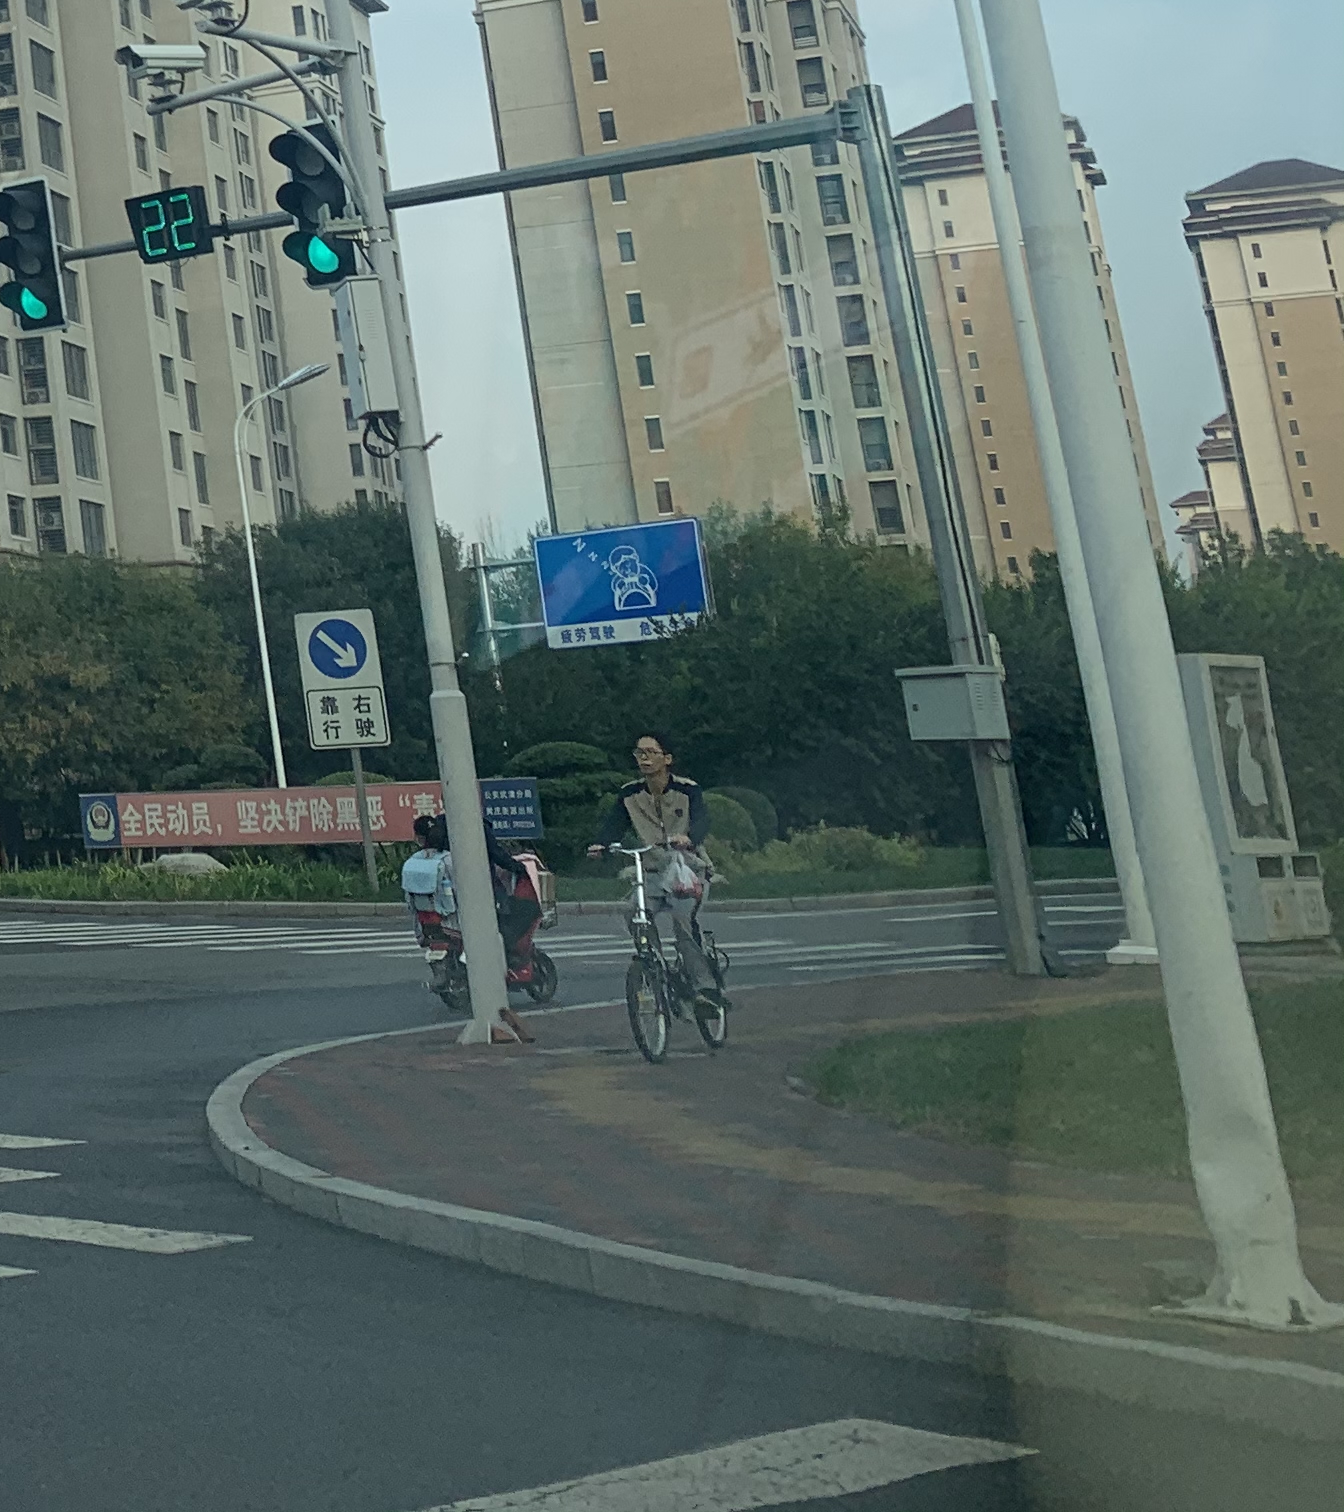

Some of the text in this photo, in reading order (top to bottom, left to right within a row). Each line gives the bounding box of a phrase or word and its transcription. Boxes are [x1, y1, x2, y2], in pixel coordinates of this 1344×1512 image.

[141, 193, 196, 257] 22
[560, 624, 616, 644] 疲劳驾驶
[320, 694, 371, 715] 靠右
[323, 717, 376, 740] 行驶
